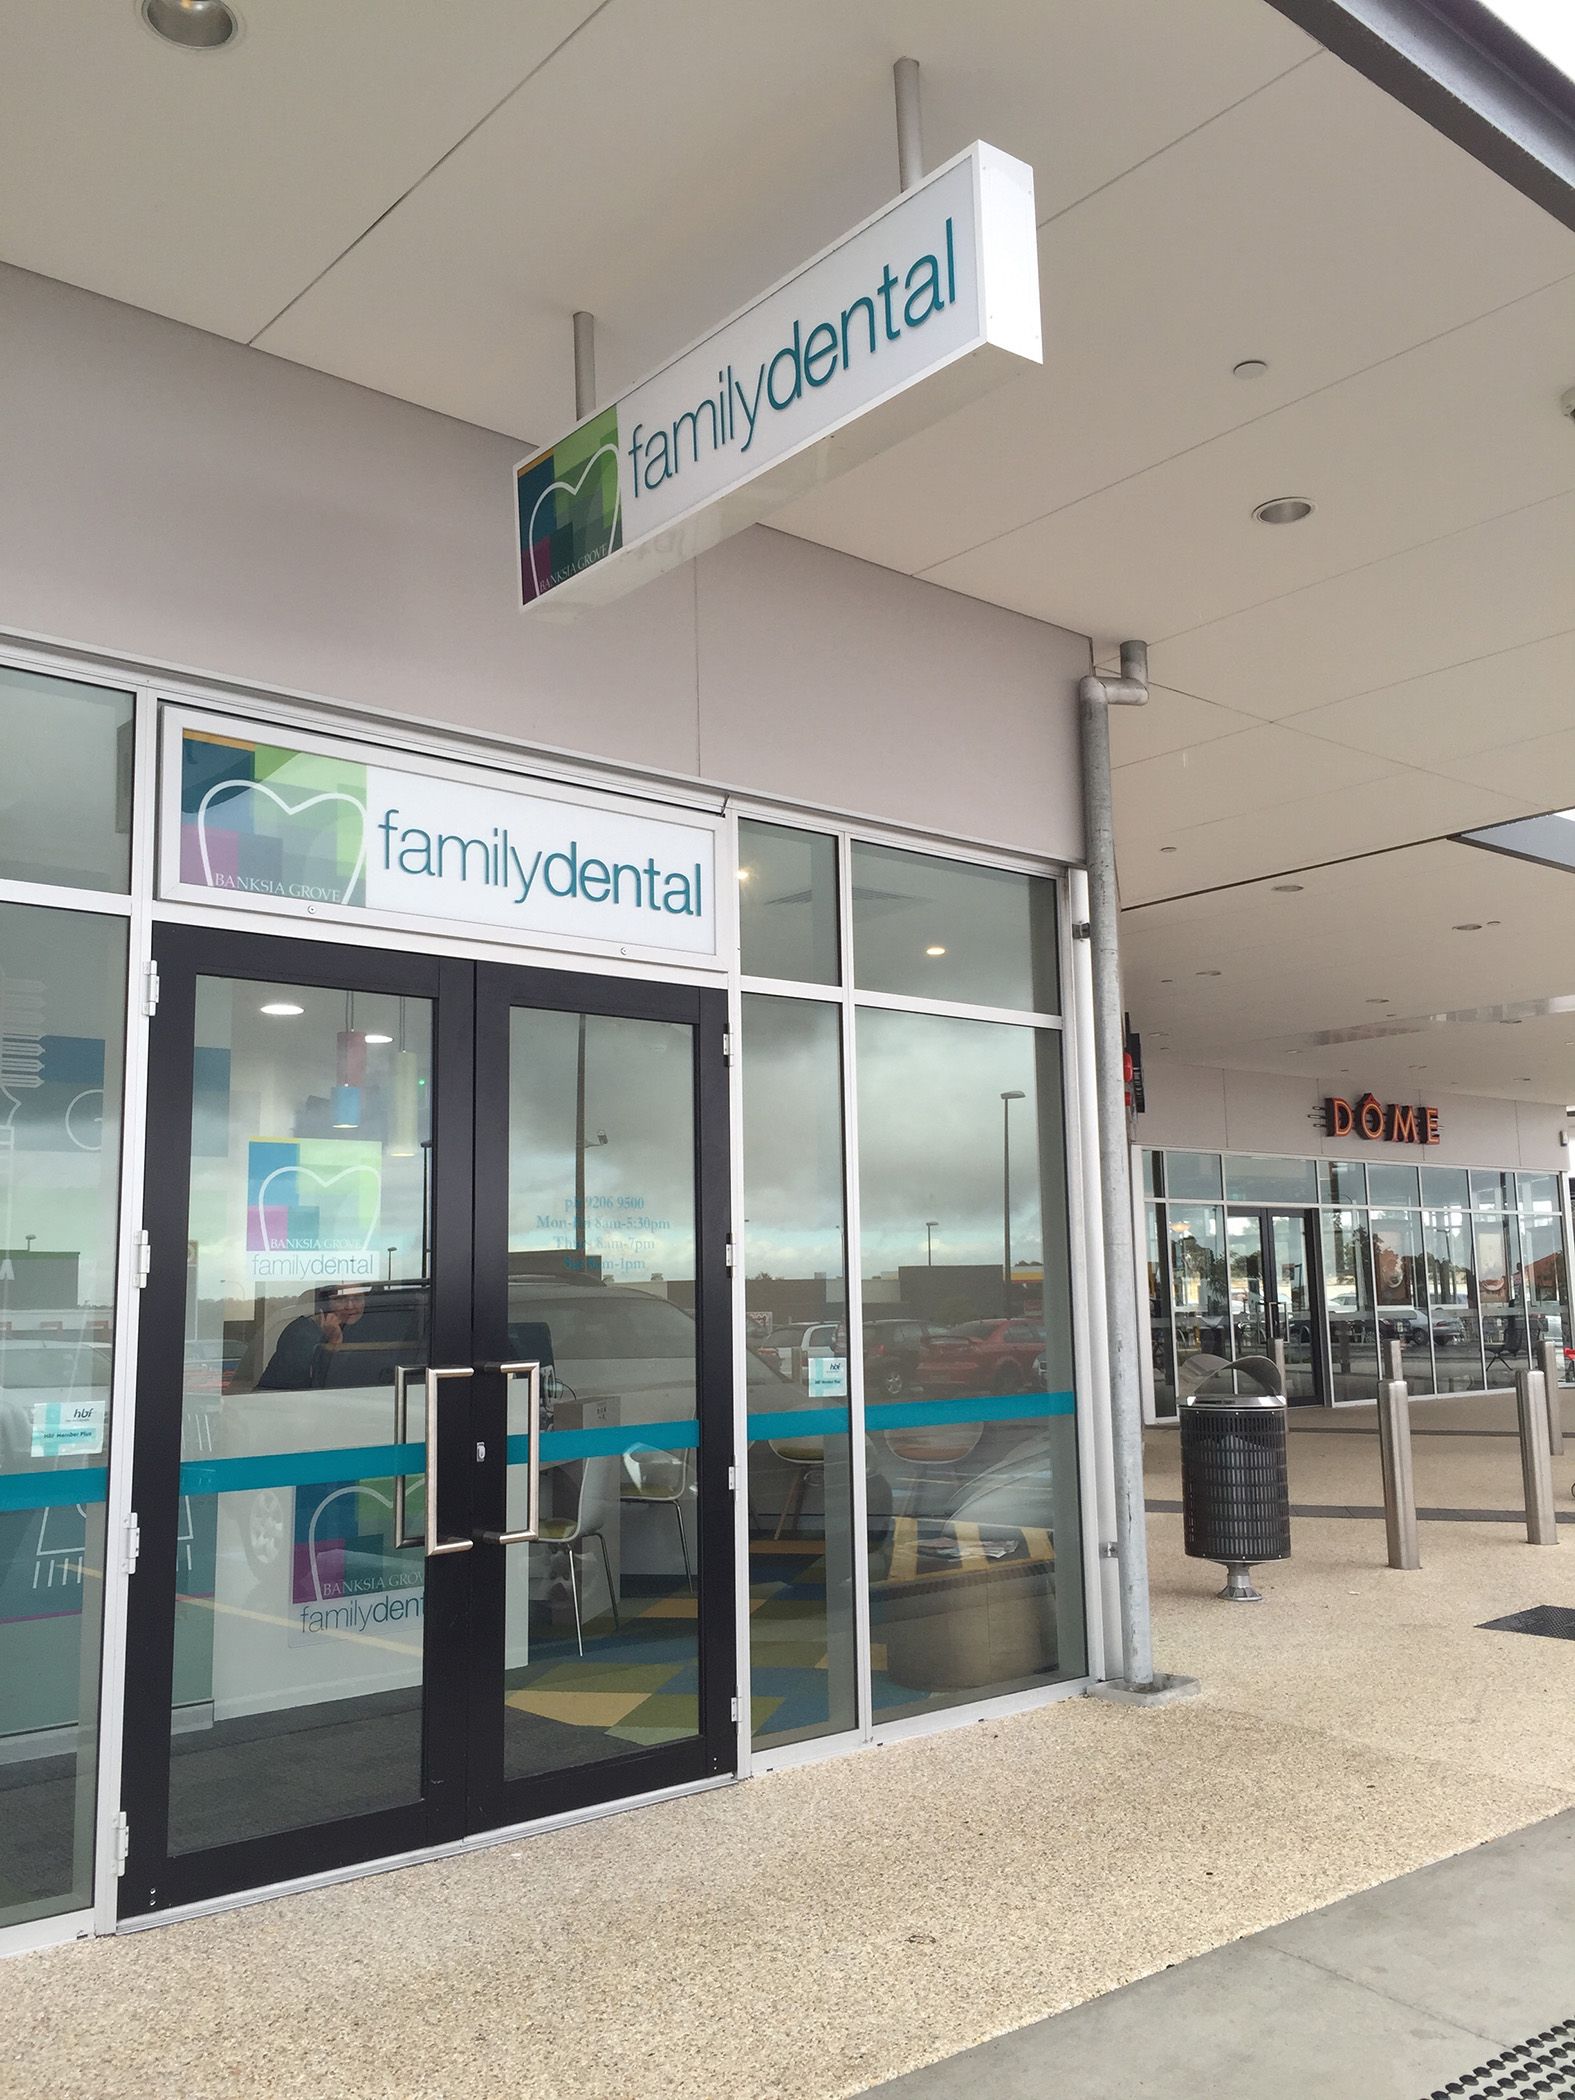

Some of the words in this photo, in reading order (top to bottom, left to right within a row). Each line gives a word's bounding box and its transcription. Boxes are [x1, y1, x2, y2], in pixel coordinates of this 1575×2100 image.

[627, 216, 957, 498] familydental
[540, 562, 578, 594] BANKSIA
[577, 543, 609, 570] GROVE
[377, 808, 703, 918] familydental
[215, 873, 285, 894] BANKSIA
[288, 884, 342, 902] GROVE
[1325, 1092, 1440, 1145] DÔME
[270, 1238, 321, 1249] BANKSIA
[323, 1238, 362, 1249] GROVE
[252, 1253, 373, 1280] familydental
[73, 1408, 94, 1418] hbf
[323, 1576, 385, 1597] BANKSIA
[388, 1572, 424, 1588] GROV
